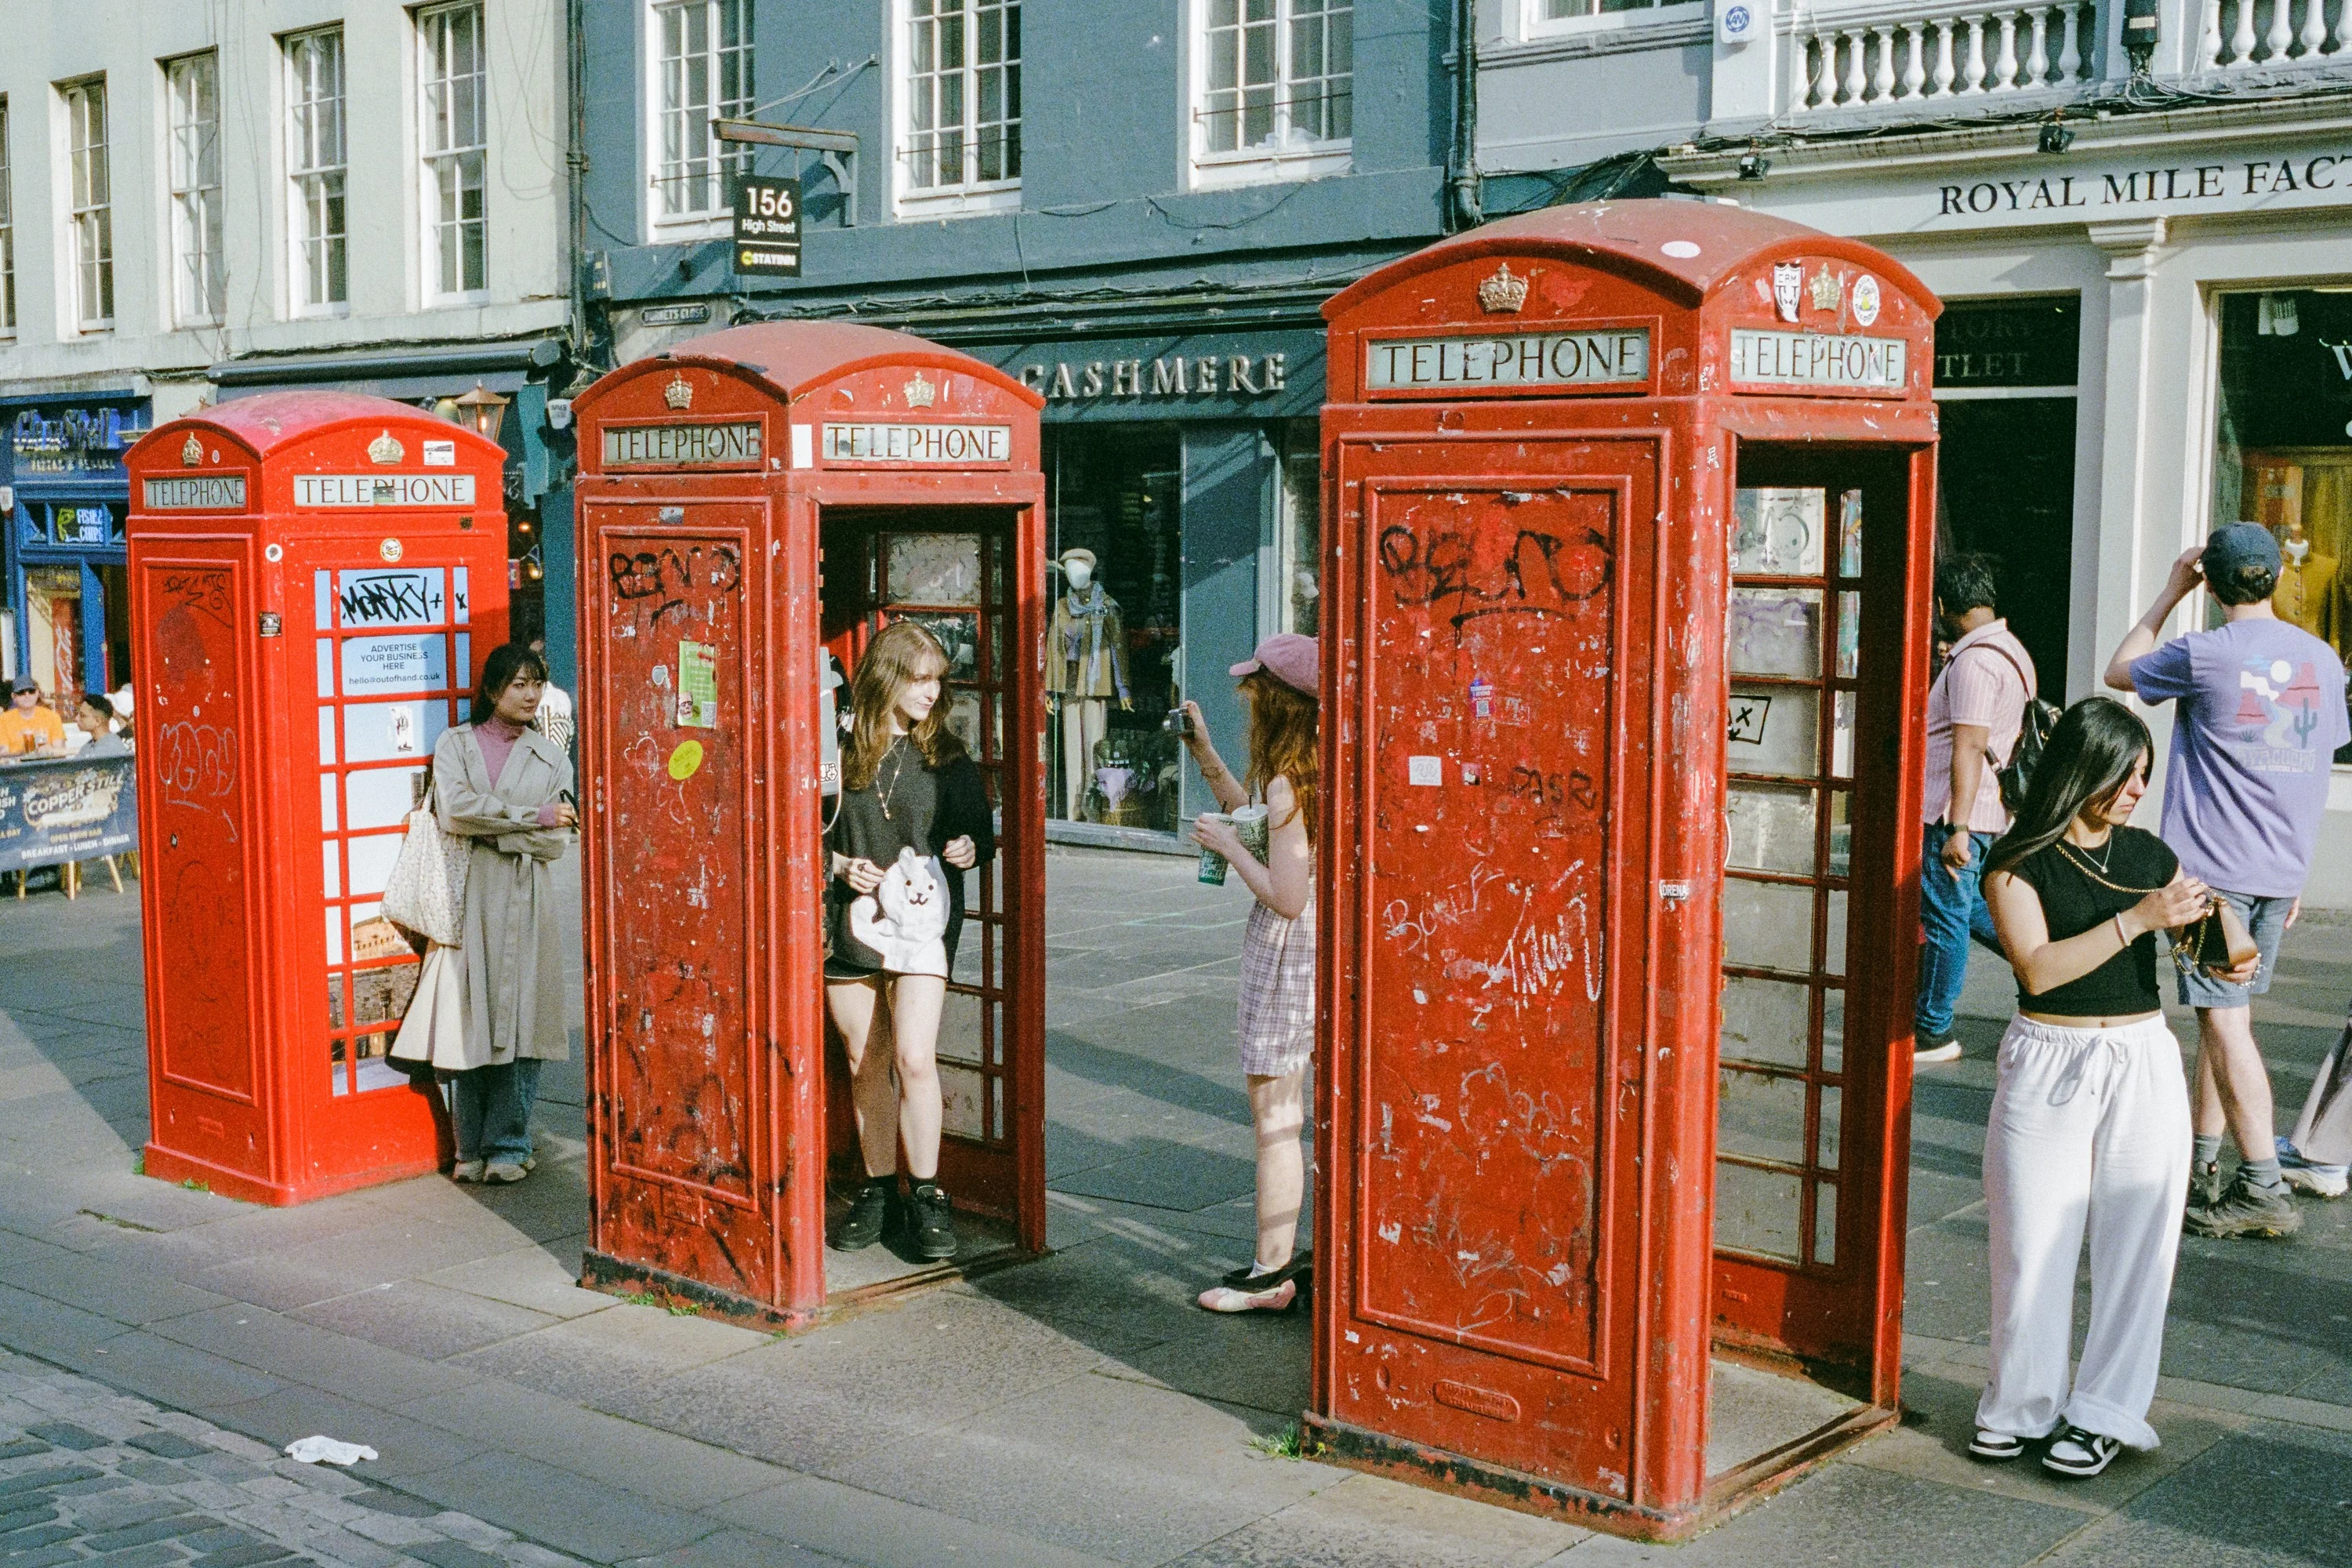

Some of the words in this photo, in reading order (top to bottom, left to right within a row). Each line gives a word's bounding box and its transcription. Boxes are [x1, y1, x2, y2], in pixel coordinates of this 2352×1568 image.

[747, 187, 792, 218] 156
[1939, 176, 2086, 215] ROYAL
[2100, 165, 2225, 205] MILE
[742, 219, 765, 234] High
[767, 220, 796, 234] Street
[1382, 336, 1640, 383] TELEPHONE
[1736, 336, 1898, 382] TELEPHONE
[1020, 354, 1284, 398] CASHMERE
[613, 426, 758, 460] TELEPHONE
[828, 426, 1001, 459] TELEPHONE
[150, 479, 245, 506] TELEPHONE
[361, 654, 384, 662] YOUR
[387, 652, 428, 661] BUSINESS
[371, 643, 417, 653] ADVERTISE
[349, 673, 440, 685] hello@outofhand.co.uk
[27, 782, 85, 815] COPPER
[86, 771, 124, 793] STILL
[21, 844, 68, 860] BREAKFAST
[74, 840, 98, 851] LUNCH
[103, 833, 130, 847] DINNER
